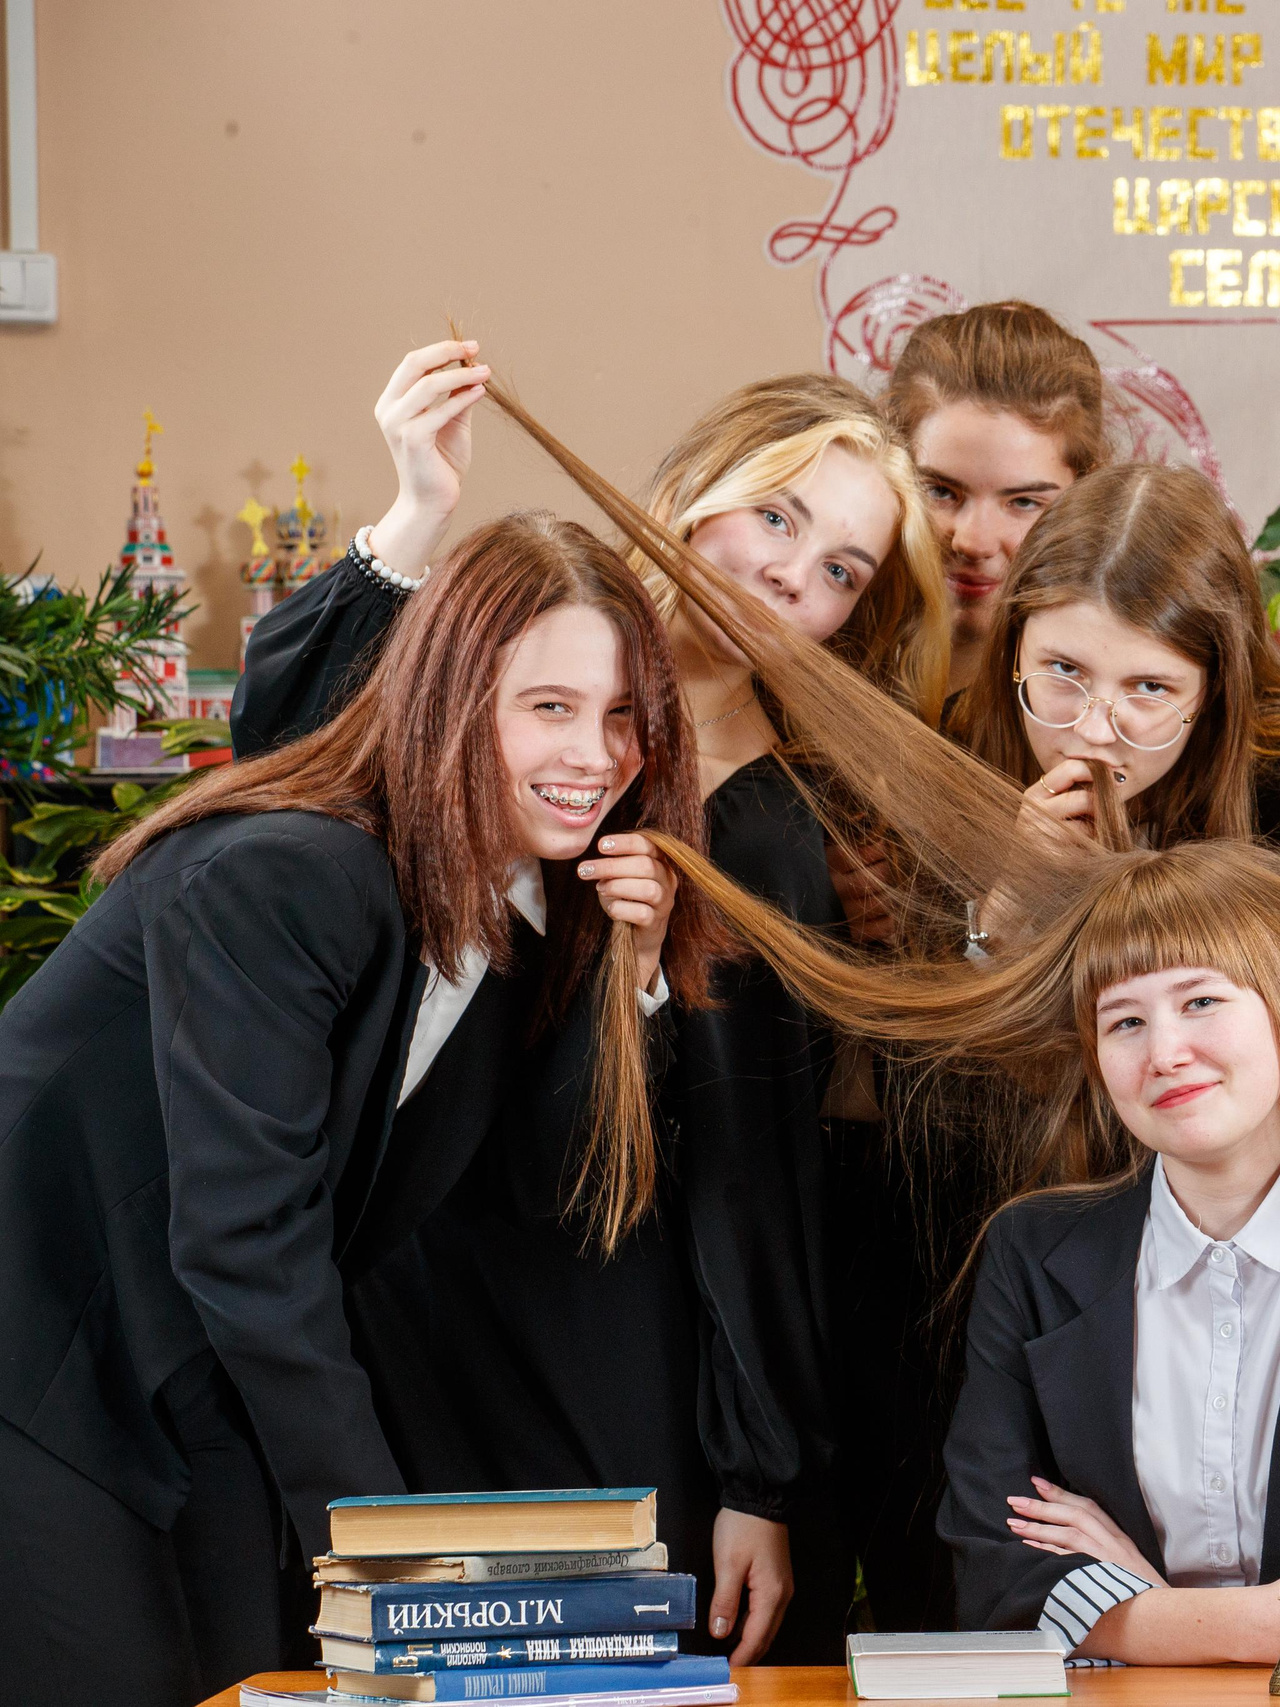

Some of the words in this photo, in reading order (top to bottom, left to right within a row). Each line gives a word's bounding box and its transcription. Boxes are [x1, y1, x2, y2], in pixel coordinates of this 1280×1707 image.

[905, 20, 1103, 86] ЦЕЛЫЙ
[1146, 33, 1263, 86] МИР
[487, 1561, 531, 1576] словарь
[533, 1552, 629, 1576] Орфографический
[633, 1600, 670, 1616] 1
[440, 1641, 487, 1656] ПОЛЯНСКИЙ
[525, 1638, 561, 1662] МИНА
[569, 1634, 655, 1660] БЛУЖДАЮЩАЯ
[446, 1652, 488, 1667] АНАТОЛИЙ
[464, 1673, 504, 1698] ГРАНИН
